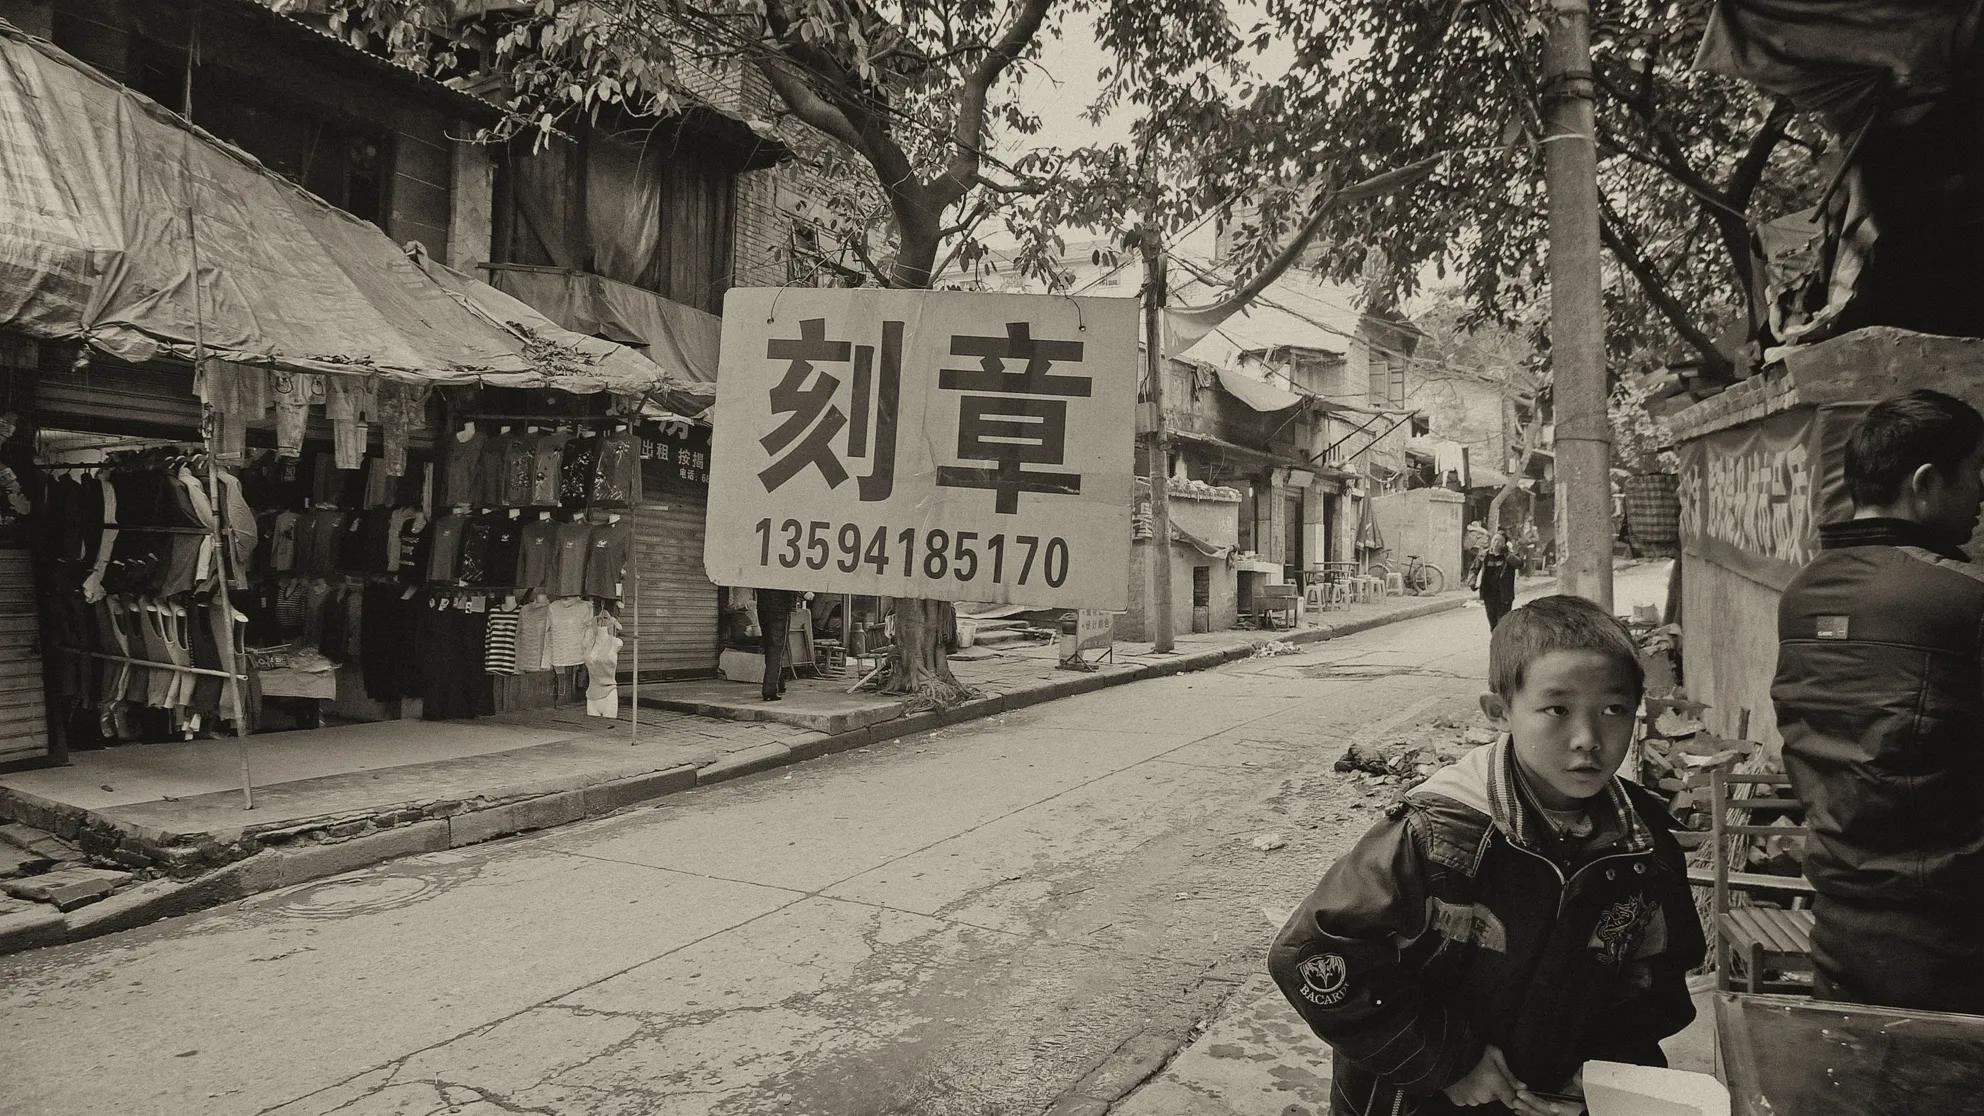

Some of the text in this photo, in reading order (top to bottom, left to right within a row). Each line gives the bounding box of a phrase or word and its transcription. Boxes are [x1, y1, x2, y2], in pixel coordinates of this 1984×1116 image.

[757, 318, 1093, 515] 刻章
[641, 439, 704, 470] 出租 按揭
[755, 517, 1070, 589] 13594185170
